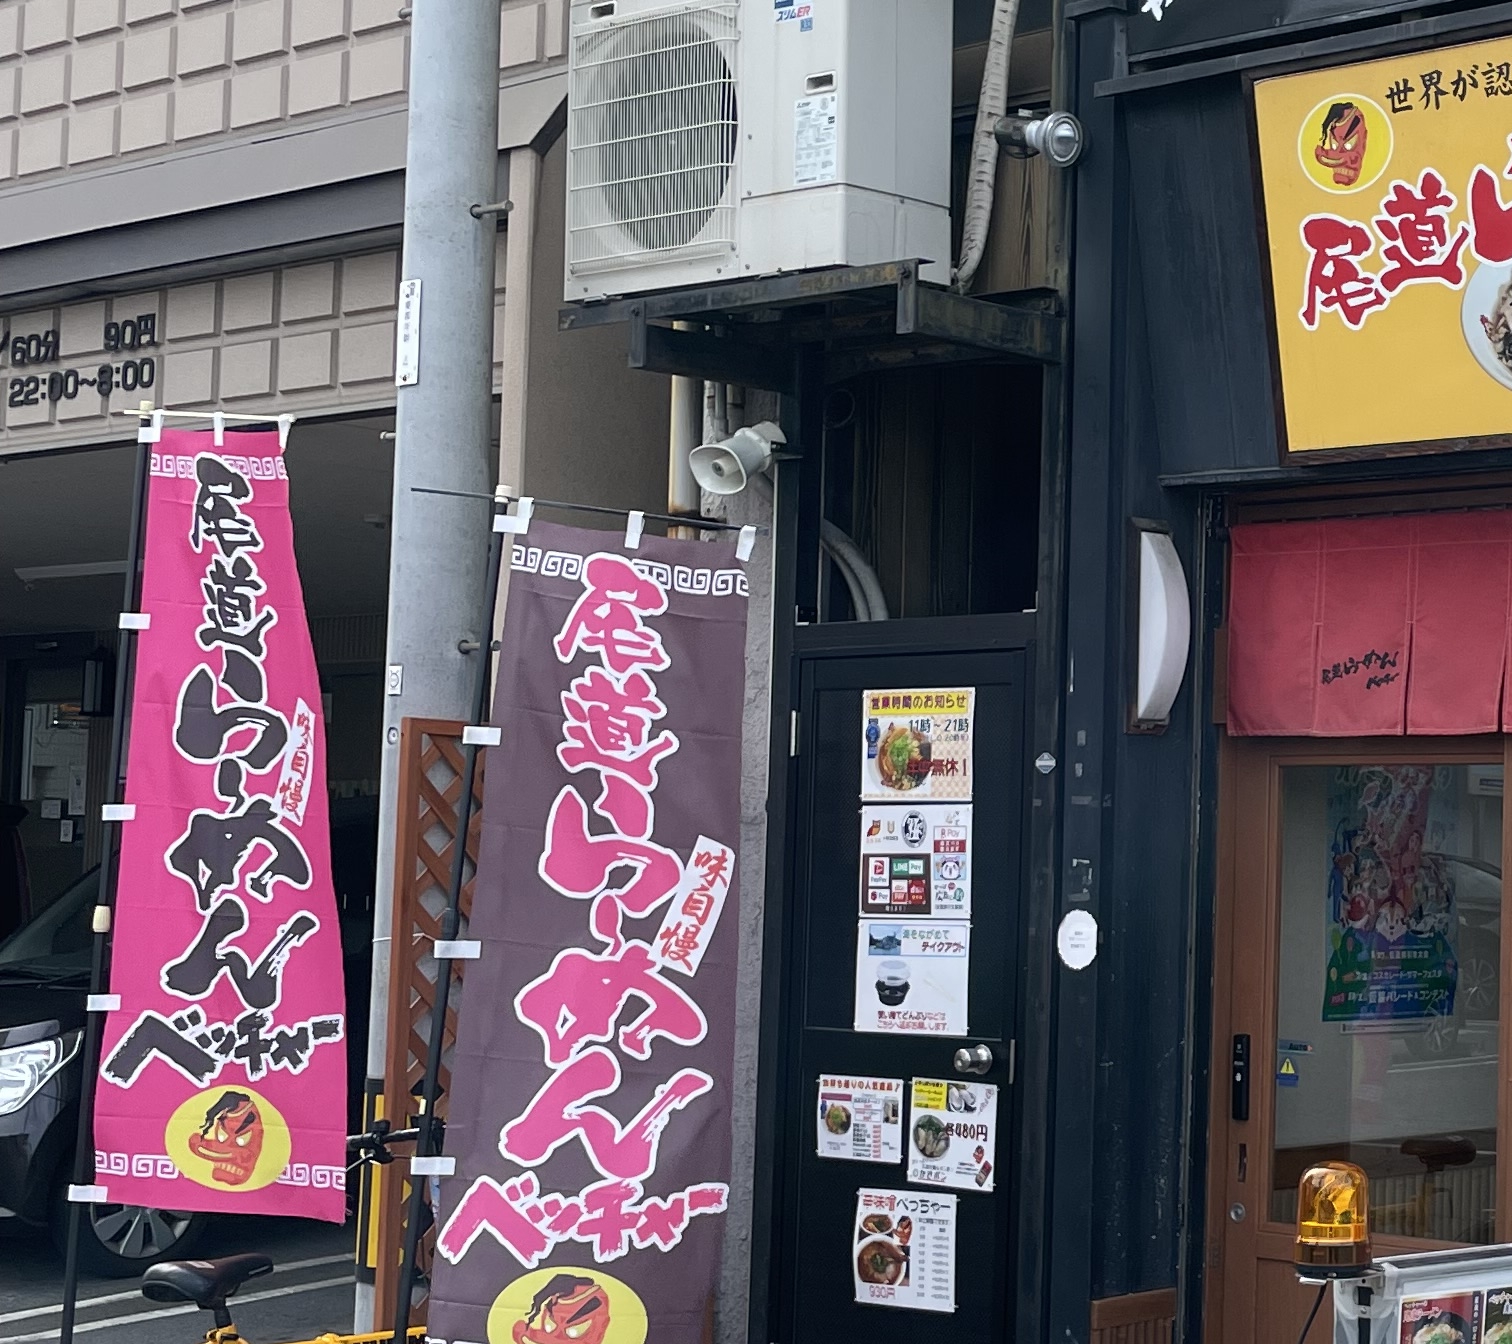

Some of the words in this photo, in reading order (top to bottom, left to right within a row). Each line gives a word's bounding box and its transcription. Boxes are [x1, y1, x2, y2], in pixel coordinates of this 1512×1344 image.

[103, 313, 157, 352] 90円
[660, 843, 731, 971] 味自慢
[101, 1009, 346, 1090] ベッチャー
[436, 1171, 730, 1269] ベッチャー
